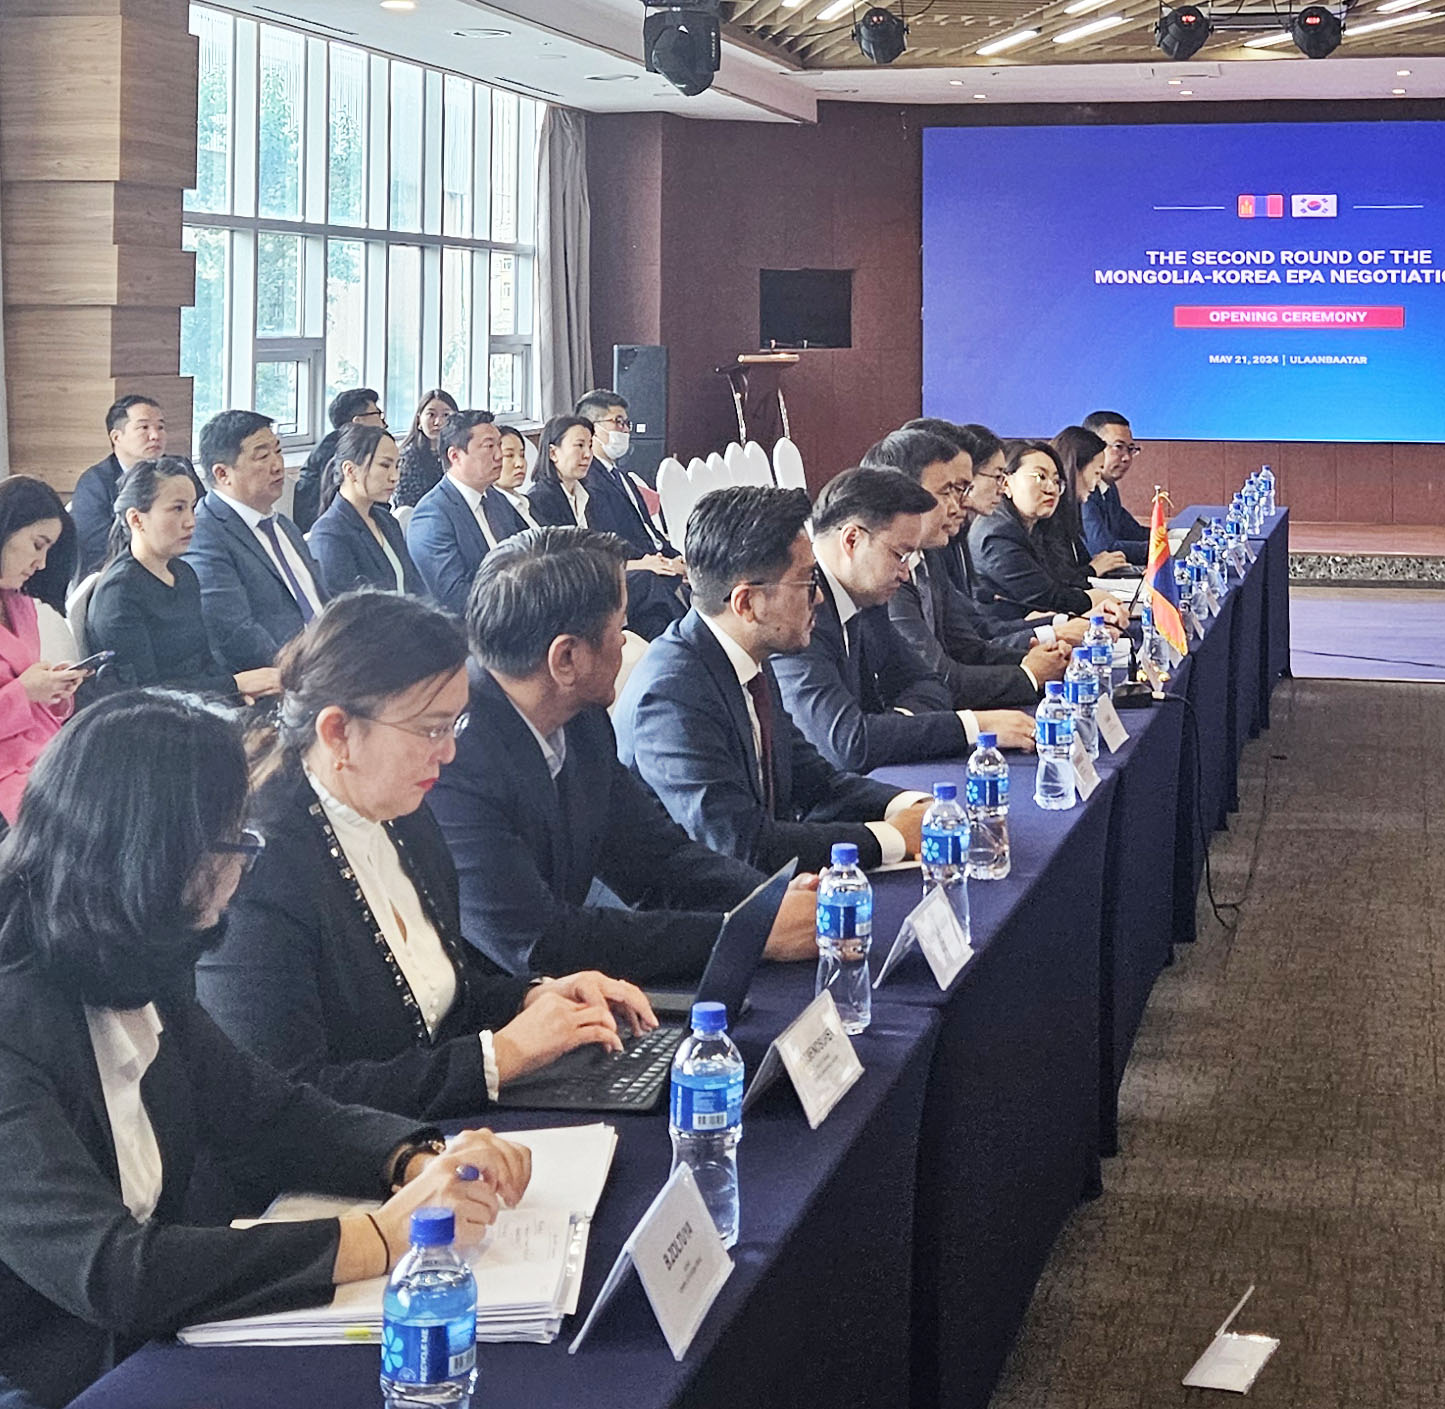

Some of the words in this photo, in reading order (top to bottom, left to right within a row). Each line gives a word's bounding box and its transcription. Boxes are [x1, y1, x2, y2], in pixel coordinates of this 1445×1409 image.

[1146, 250, 1187, 265] THE
[1191, 250, 1276, 265] SECOND
[1281, 250, 1353, 265] ROUND
[1357, 250, 1386, 265] OF
[1390, 249, 1433, 264] THE
[1094, 269, 1281, 285] MONGOLIA-KOREA
[1286, 269, 1326, 284] EPA
[1208, 310, 1279, 323] OPENING
[1281, 310, 1368, 323] CEREMONY
[1208, 354, 1232, 365] MAY
[1234, 354, 1251, 367] 21,
[1252, 354, 1279, 365] 2024
[1289, 354, 1368, 365] ULAANBAATAR
